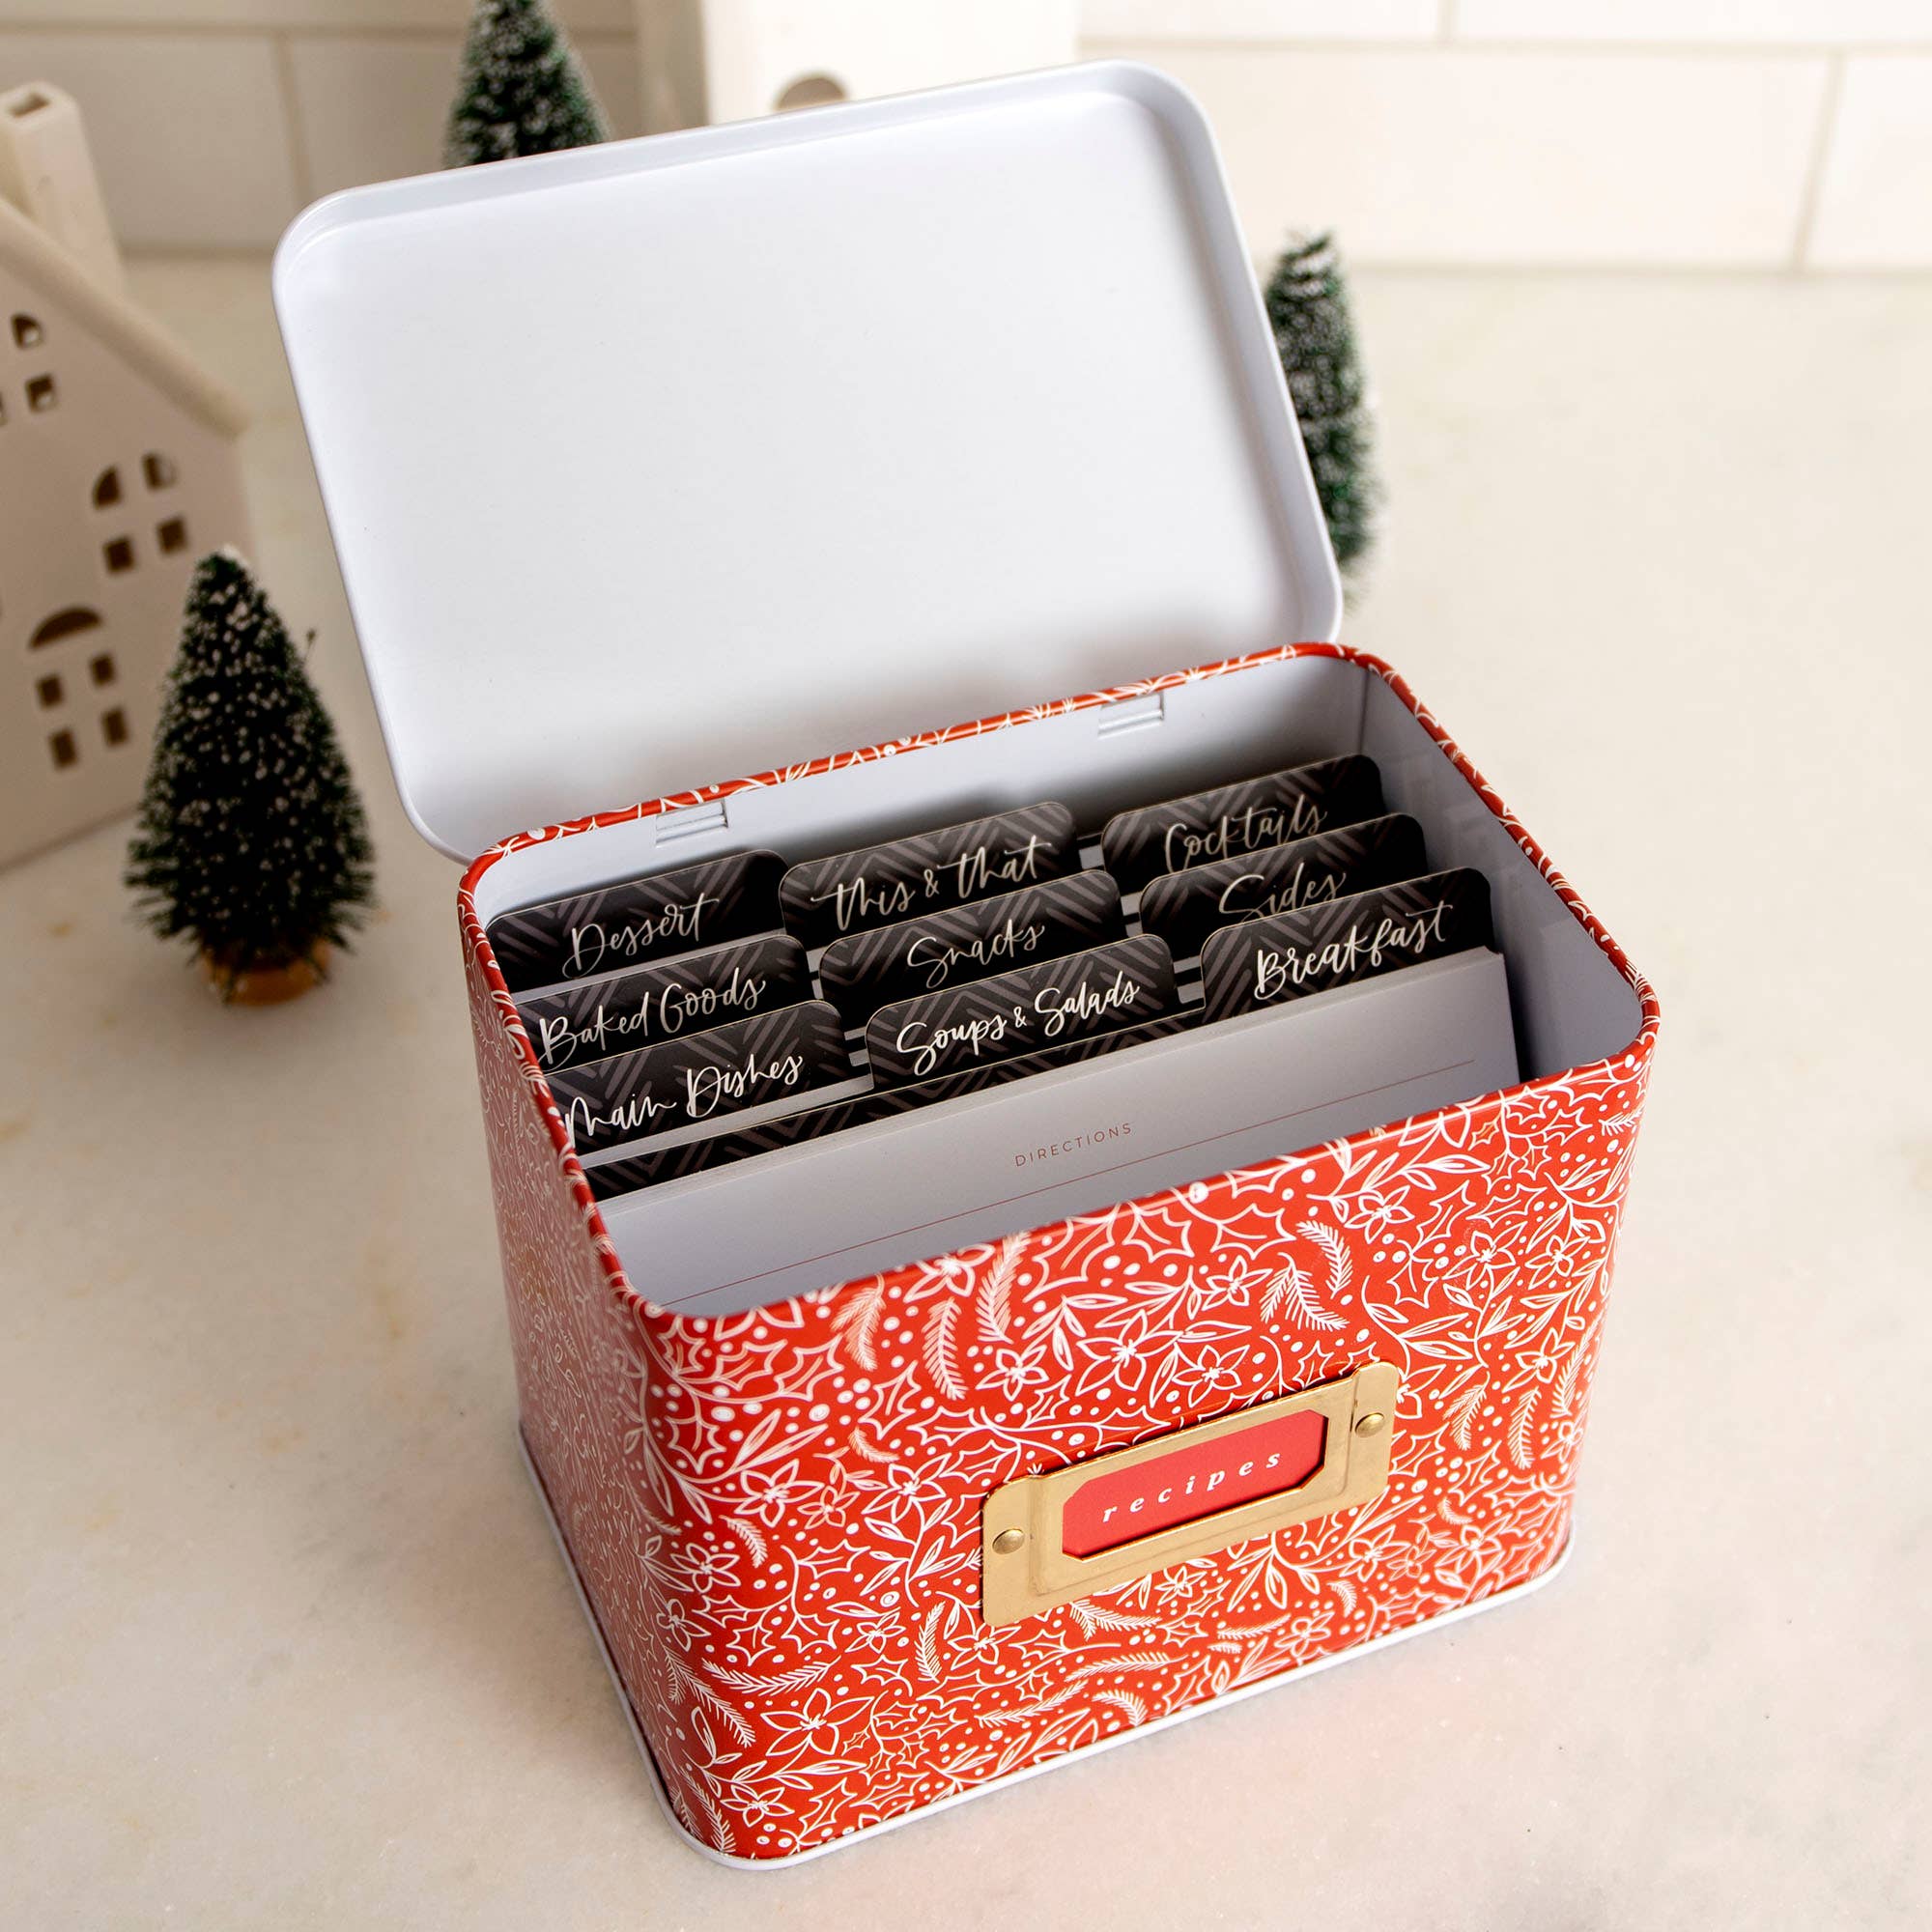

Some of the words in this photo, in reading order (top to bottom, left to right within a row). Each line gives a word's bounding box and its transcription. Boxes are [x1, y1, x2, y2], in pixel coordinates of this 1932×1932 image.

[1165, 794, 1327, 870] Cocktails
[923, 868, 940, 898] &
[1219, 863, 1347, 922] Sides
[562, 893, 720, 978] Dessert
[906, 919, 1045, 988] Snacks
[1254, 900, 1454, 1001] Breakfast
[537, 992, 649, 1071] Baked
[659, 967, 766, 1033] Goods
[896, 1012, 1008, 1076] Soups
[1013, 1007, 1027, 1027] &
[1035, 971, 1140, 1037] Salads
[686, 1054, 803, 1119] Dishes
[1014, 1122, 1133, 1168] DIRECTIONS
[1102, 1451, 1281, 1523] recipes
